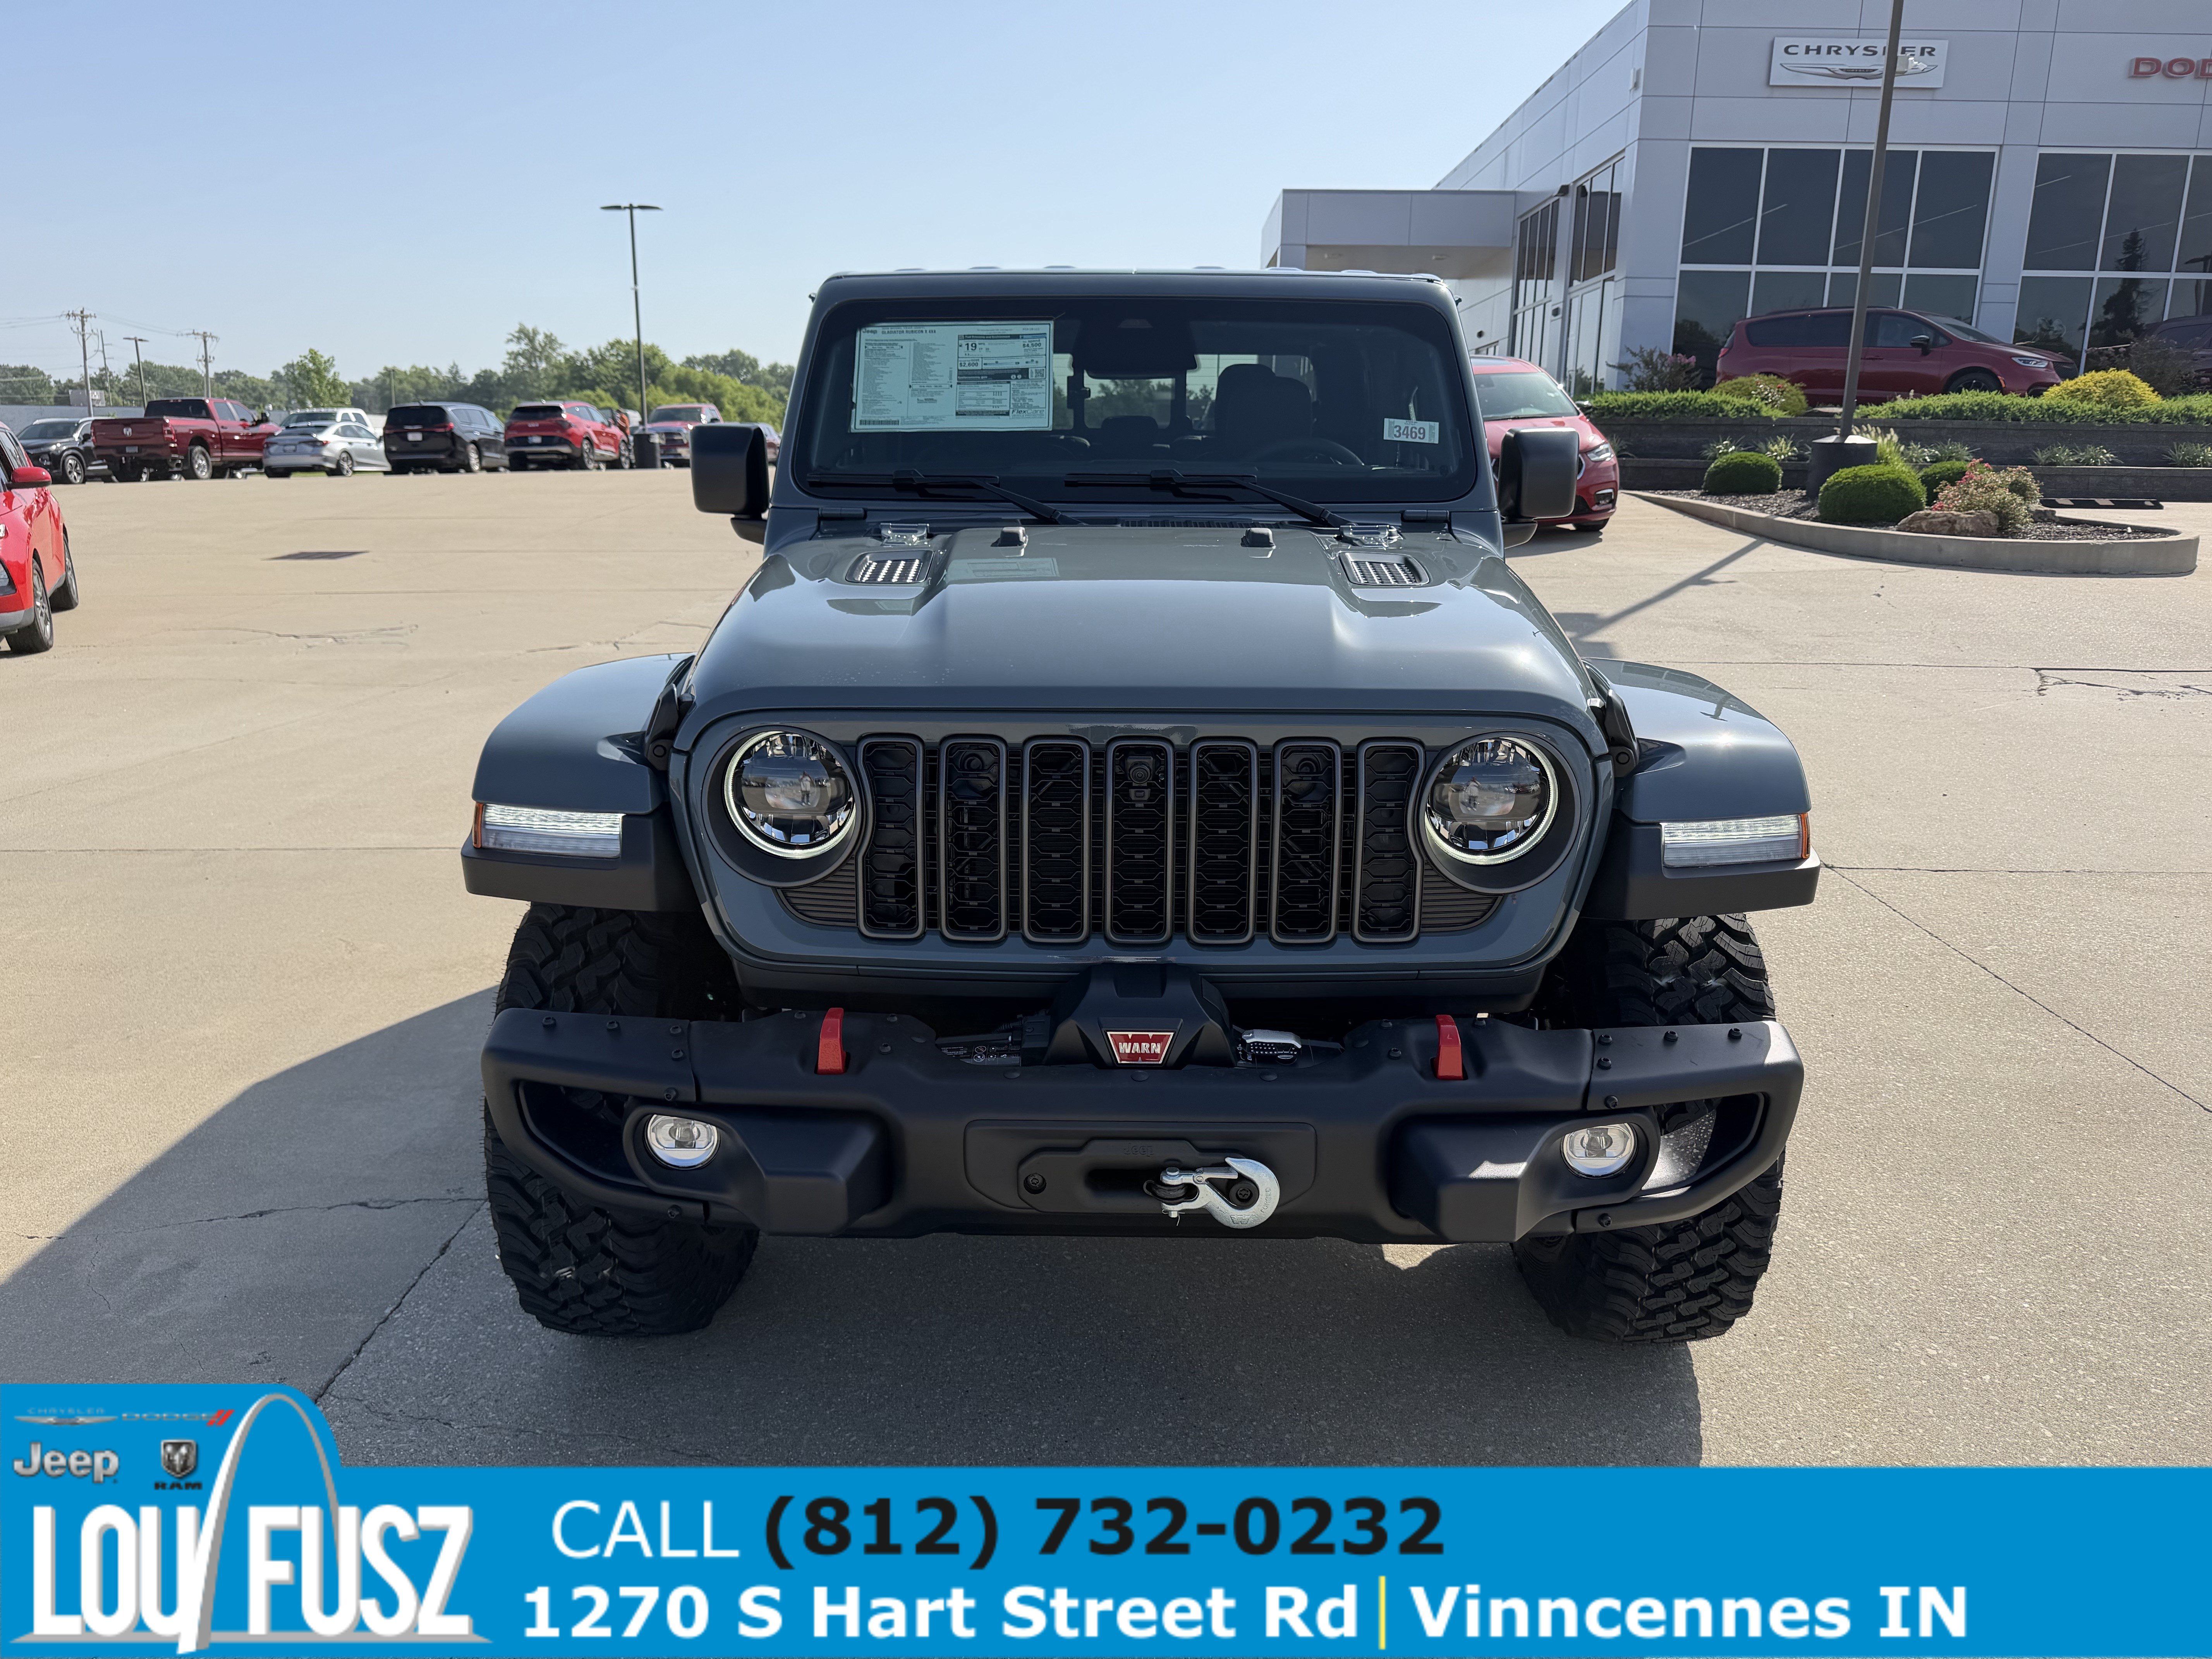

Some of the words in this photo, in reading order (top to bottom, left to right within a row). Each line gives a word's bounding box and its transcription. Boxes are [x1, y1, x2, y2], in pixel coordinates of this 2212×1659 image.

[1783, 45, 1936, 57] CHRYSER
[965, 343, 977, 351] 19
[1394, 425, 1425, 440] 3469
[1118, 1042, 1161, 1054] WARN
